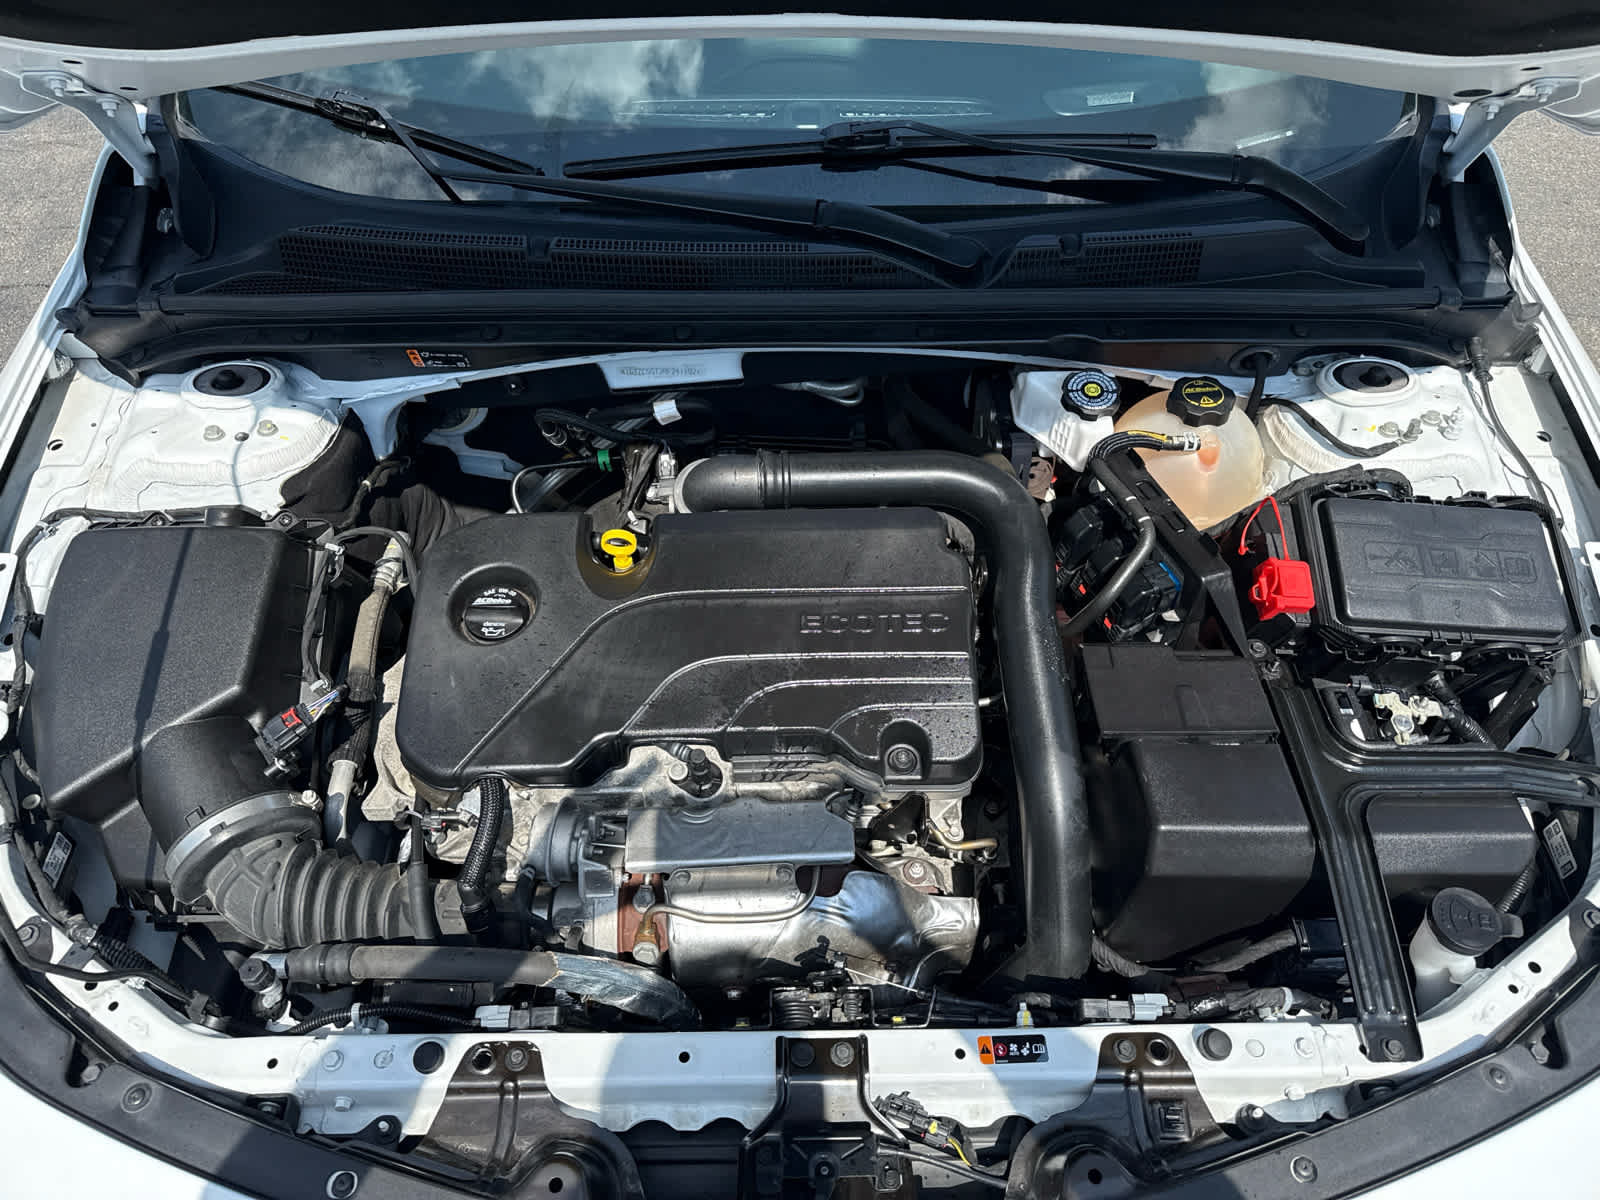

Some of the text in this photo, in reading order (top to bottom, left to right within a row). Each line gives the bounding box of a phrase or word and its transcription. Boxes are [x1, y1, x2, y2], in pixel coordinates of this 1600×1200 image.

[483, 588, 496, 597] SAE
[472, 597, 512, 606] ACDelco
[800, 613, 950, 633] ECOTEC
